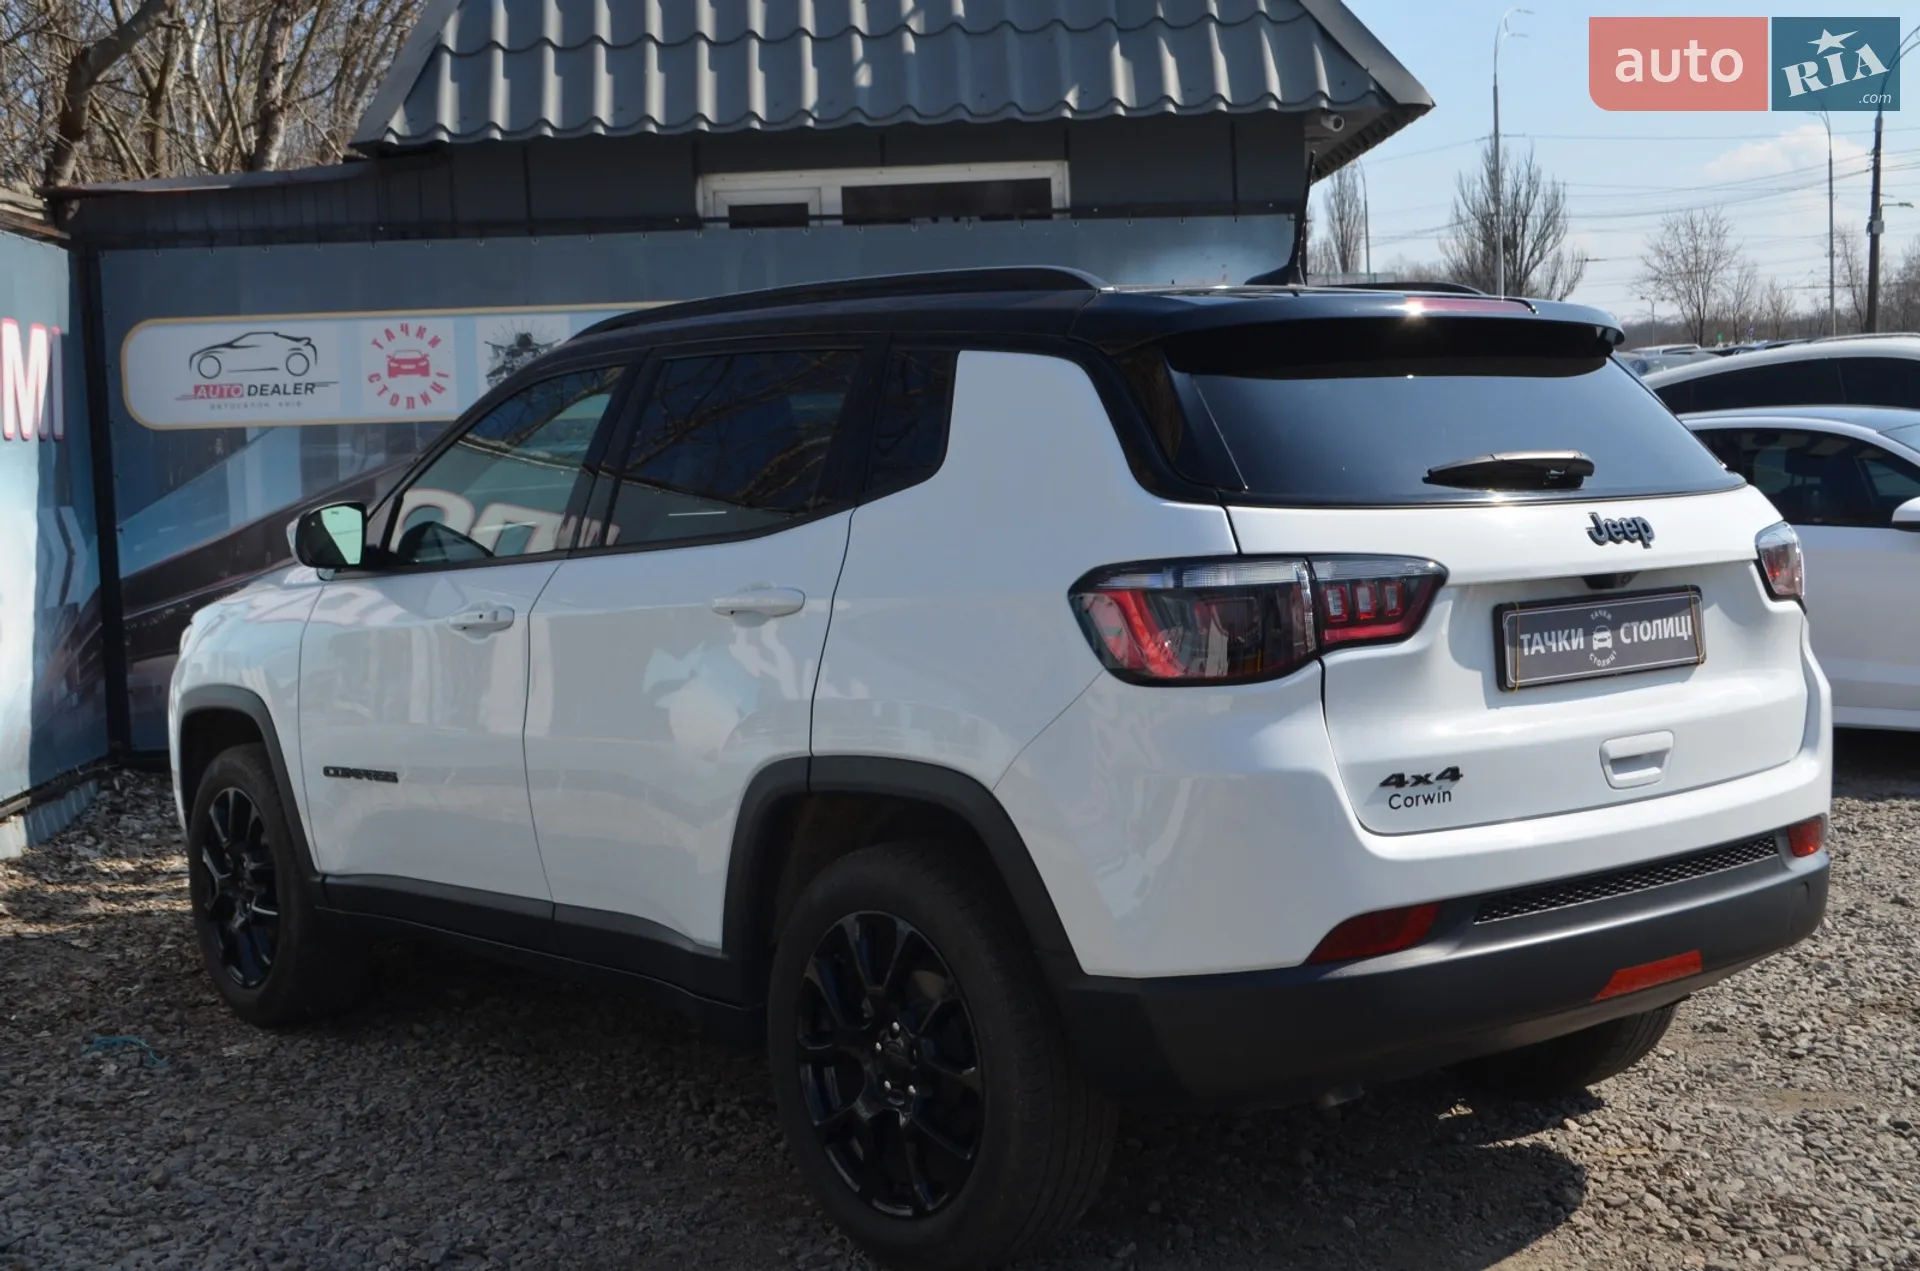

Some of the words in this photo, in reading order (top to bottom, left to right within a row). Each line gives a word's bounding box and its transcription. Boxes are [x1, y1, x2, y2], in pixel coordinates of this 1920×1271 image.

[371, 323, 442, 350] ТАЧКИ
[195, 385, 243, 399] AUTO
[247, 383, 316, 397] DEALER
[368, 371, 450, 410] СТОЛИЦІ
[1585, 512, 1655, 549] Jeep
[1520, 628, 1584, 656] ТАЧКИ
[1619, 615, 1692, 645] СТОЛИЦІ
[1379, 766, 1463, 788] 4x4
[1388, 785, 1452, 810] Corwin
